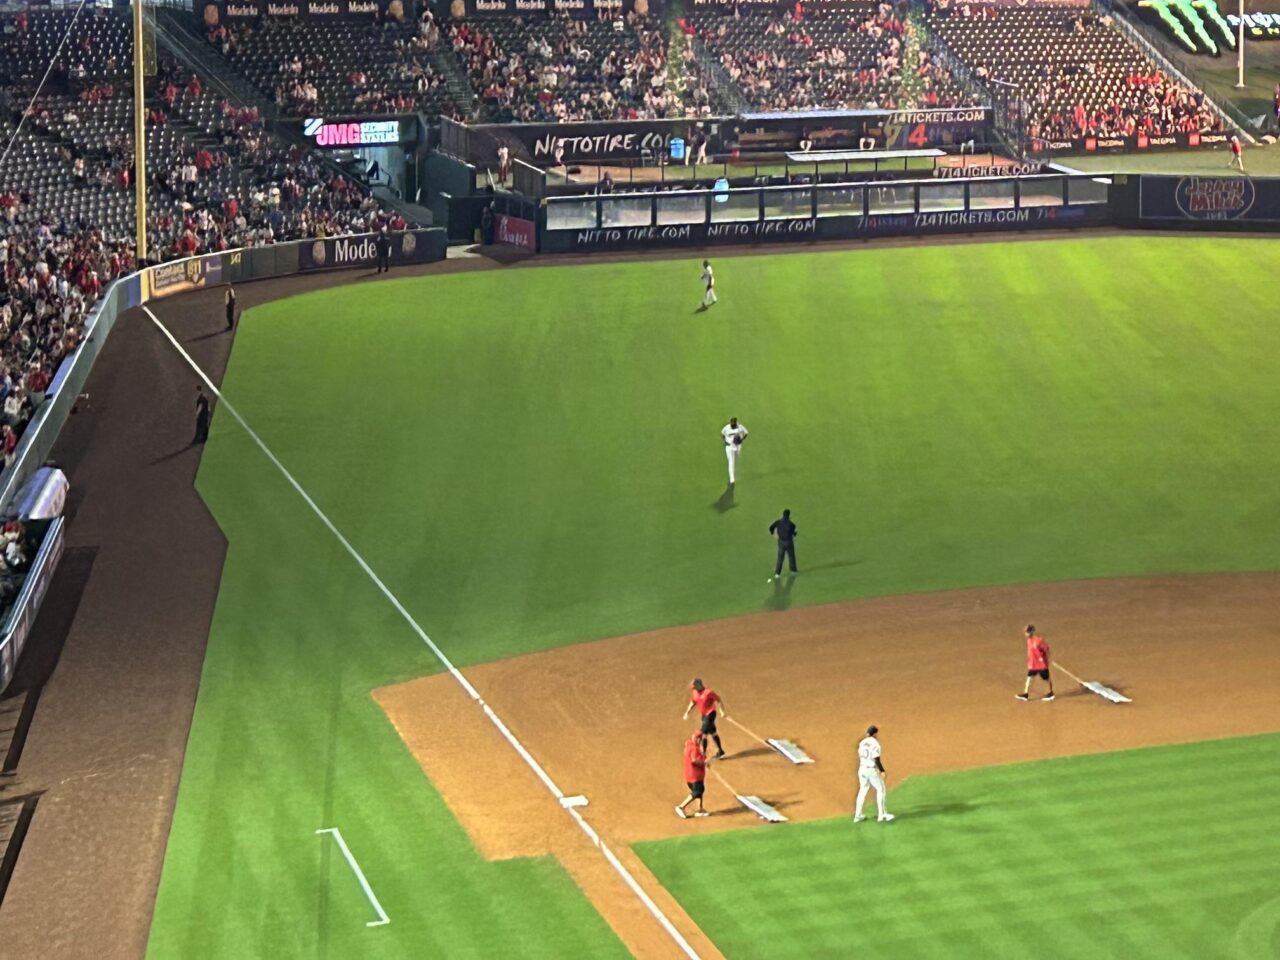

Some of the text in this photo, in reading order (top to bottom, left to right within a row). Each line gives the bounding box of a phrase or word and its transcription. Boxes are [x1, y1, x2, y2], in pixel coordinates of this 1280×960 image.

[227, 5, 258, 16] Modelo
[268, 3, 299, 15] Modelo
[308, 2, 339, 14] Modelo
[348, 1, 379, 13] Modelo
[316, 123, 360, 146] JMG
[335, 238, 392, 262] Mode
